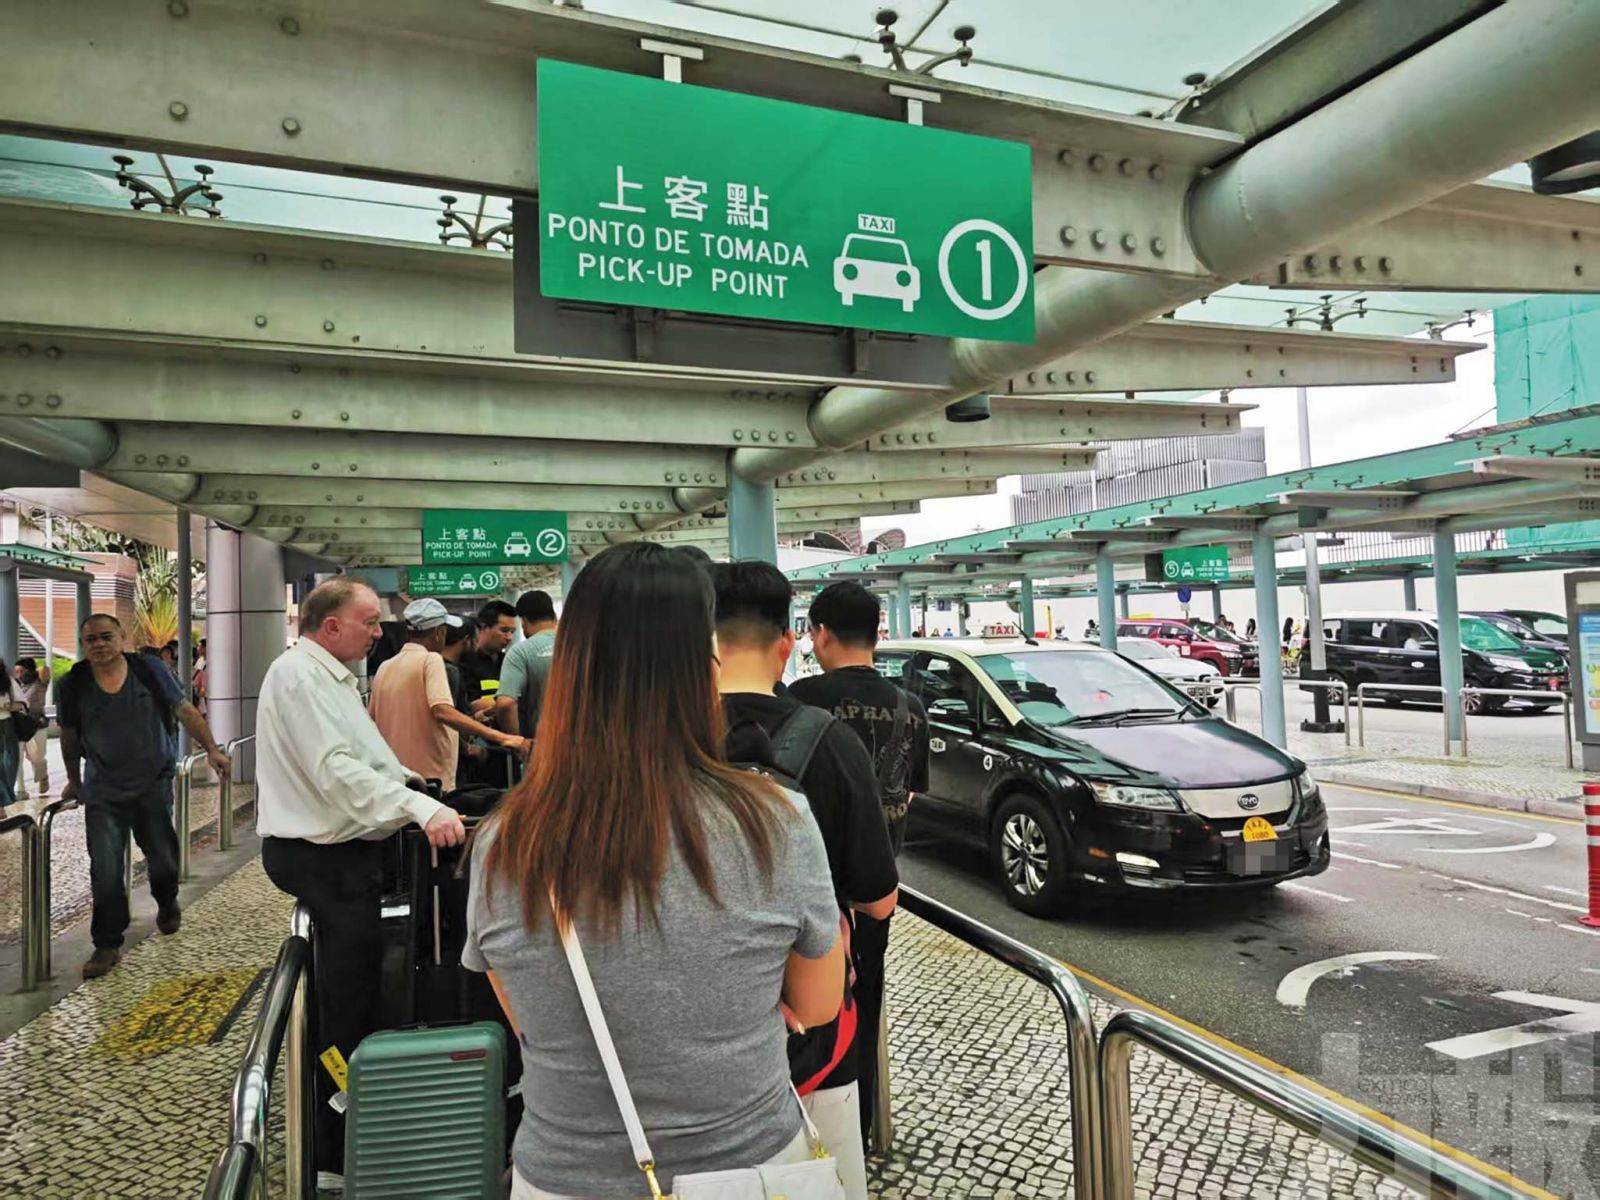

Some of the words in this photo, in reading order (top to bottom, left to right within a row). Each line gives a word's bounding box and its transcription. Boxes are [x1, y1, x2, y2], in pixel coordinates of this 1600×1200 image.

[598, 164, 770, 231] 上客點
[860, 215, 894, 232] TAXI
[548, 213, 645, 248] PONTO
[655, 227, 690, 254] DE
[700, 232, 809, 268] TOMADA
[578, 253, 692, 288] PICK-UP
[712, 268, 788, 299] POINT
[975, 239, 992, 301] 1
[425, 541, 452, 550] PONTO
[453, 541, 464, 550] DE
[466, 541, 498, 550] TOMADA
[545, 533, 558, 551] 2
[433, 550, 465, 558] PICK-UP
[468, 550, 491, 558] POINT
[1168, 563, 1176, 575] 5
[484, 574, 494, 587] 3
[989, 625, 1014, 636] TAXI
